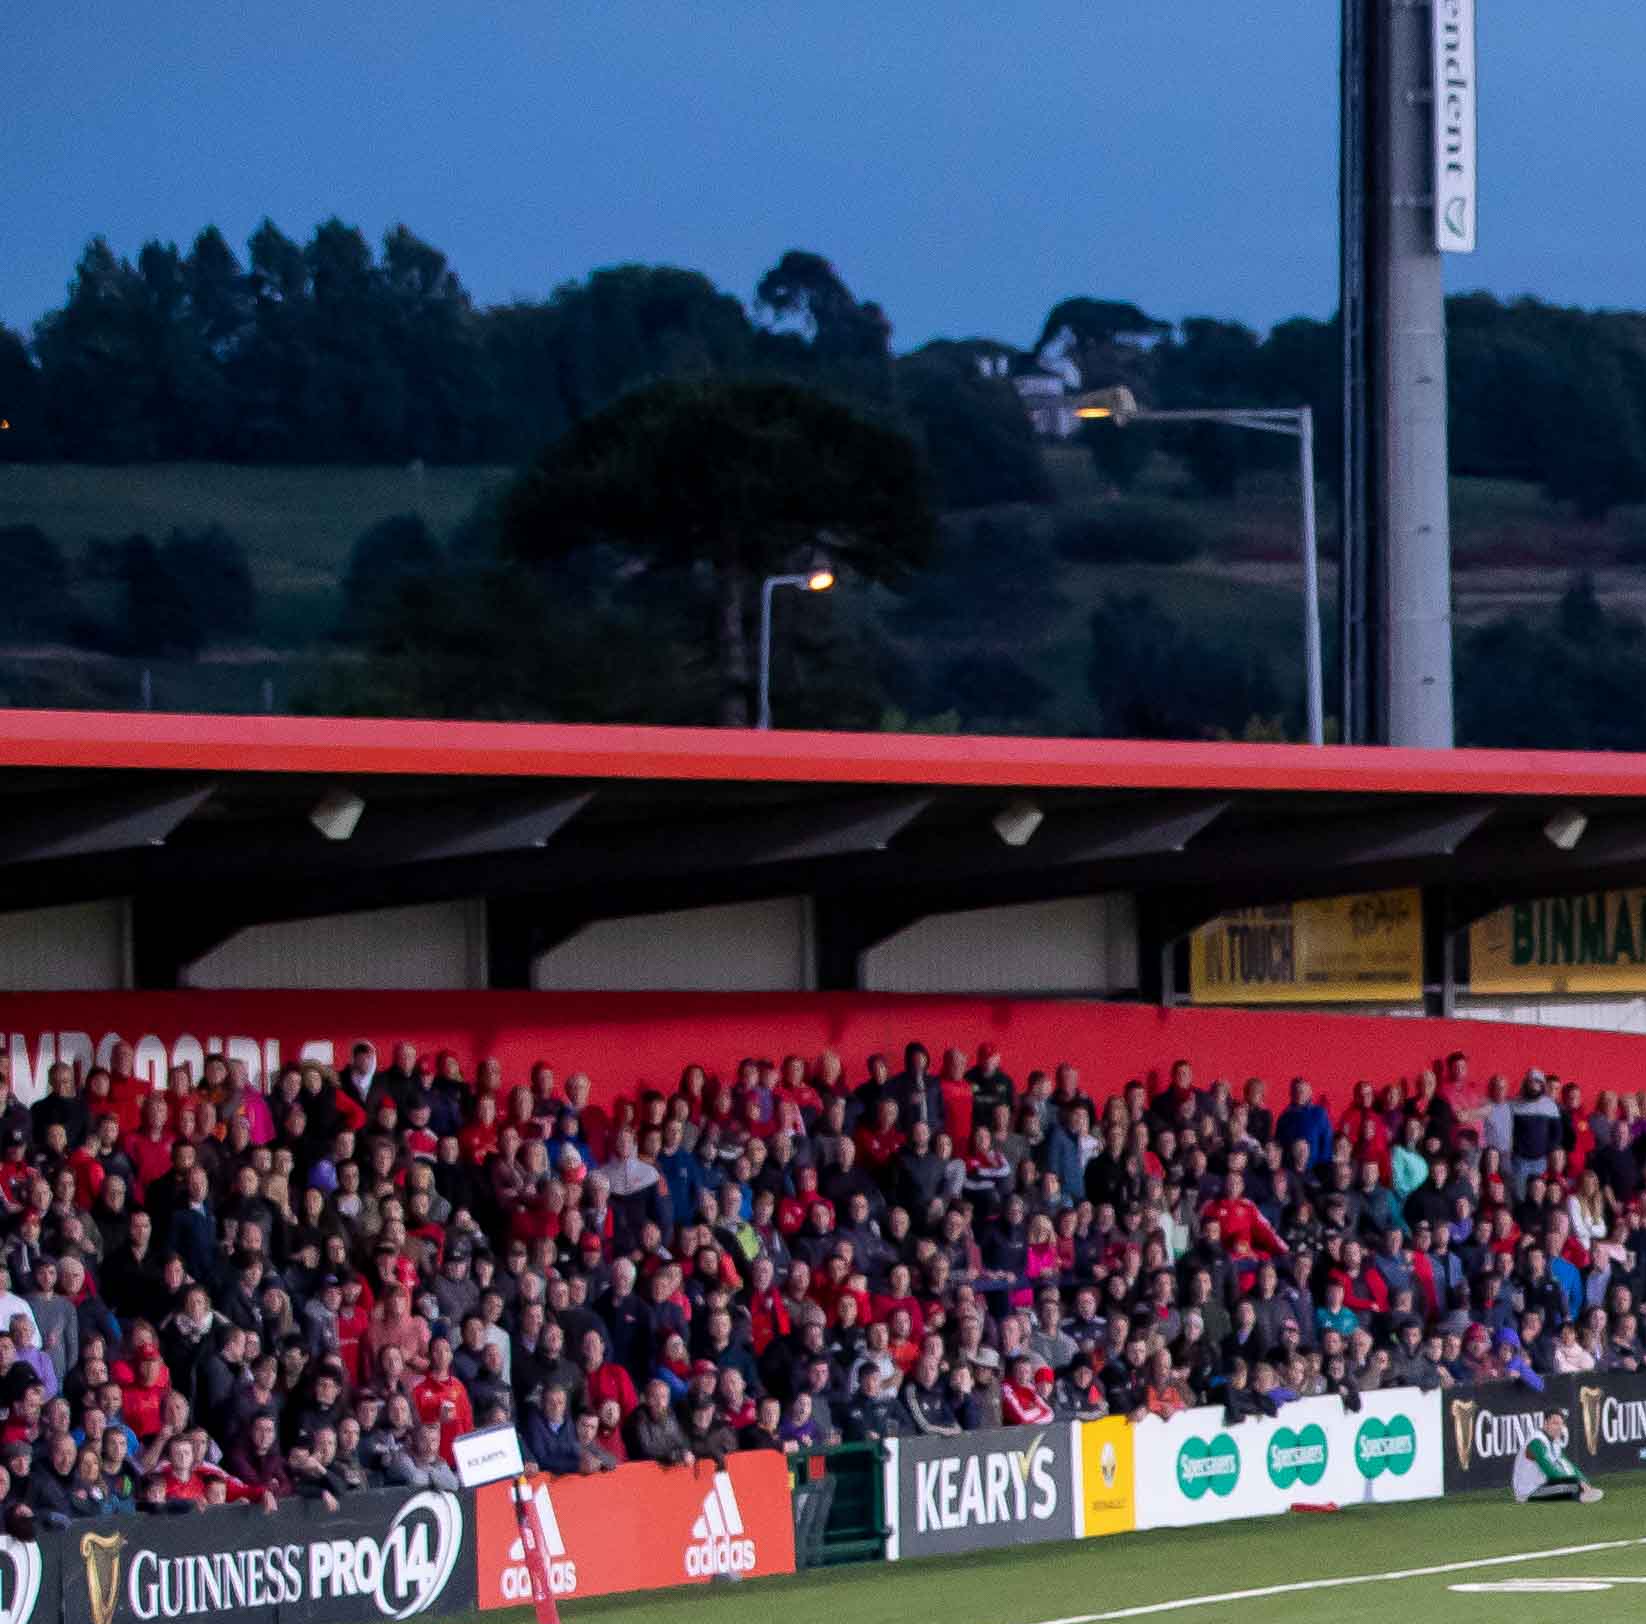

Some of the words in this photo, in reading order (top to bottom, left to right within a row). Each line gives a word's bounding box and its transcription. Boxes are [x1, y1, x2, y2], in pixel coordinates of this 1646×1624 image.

[684, 1535, 756, 1577] adidas
[128, 1543, 303, 1621] GUINNESS
[501, 1559, 577, 1600] adas
